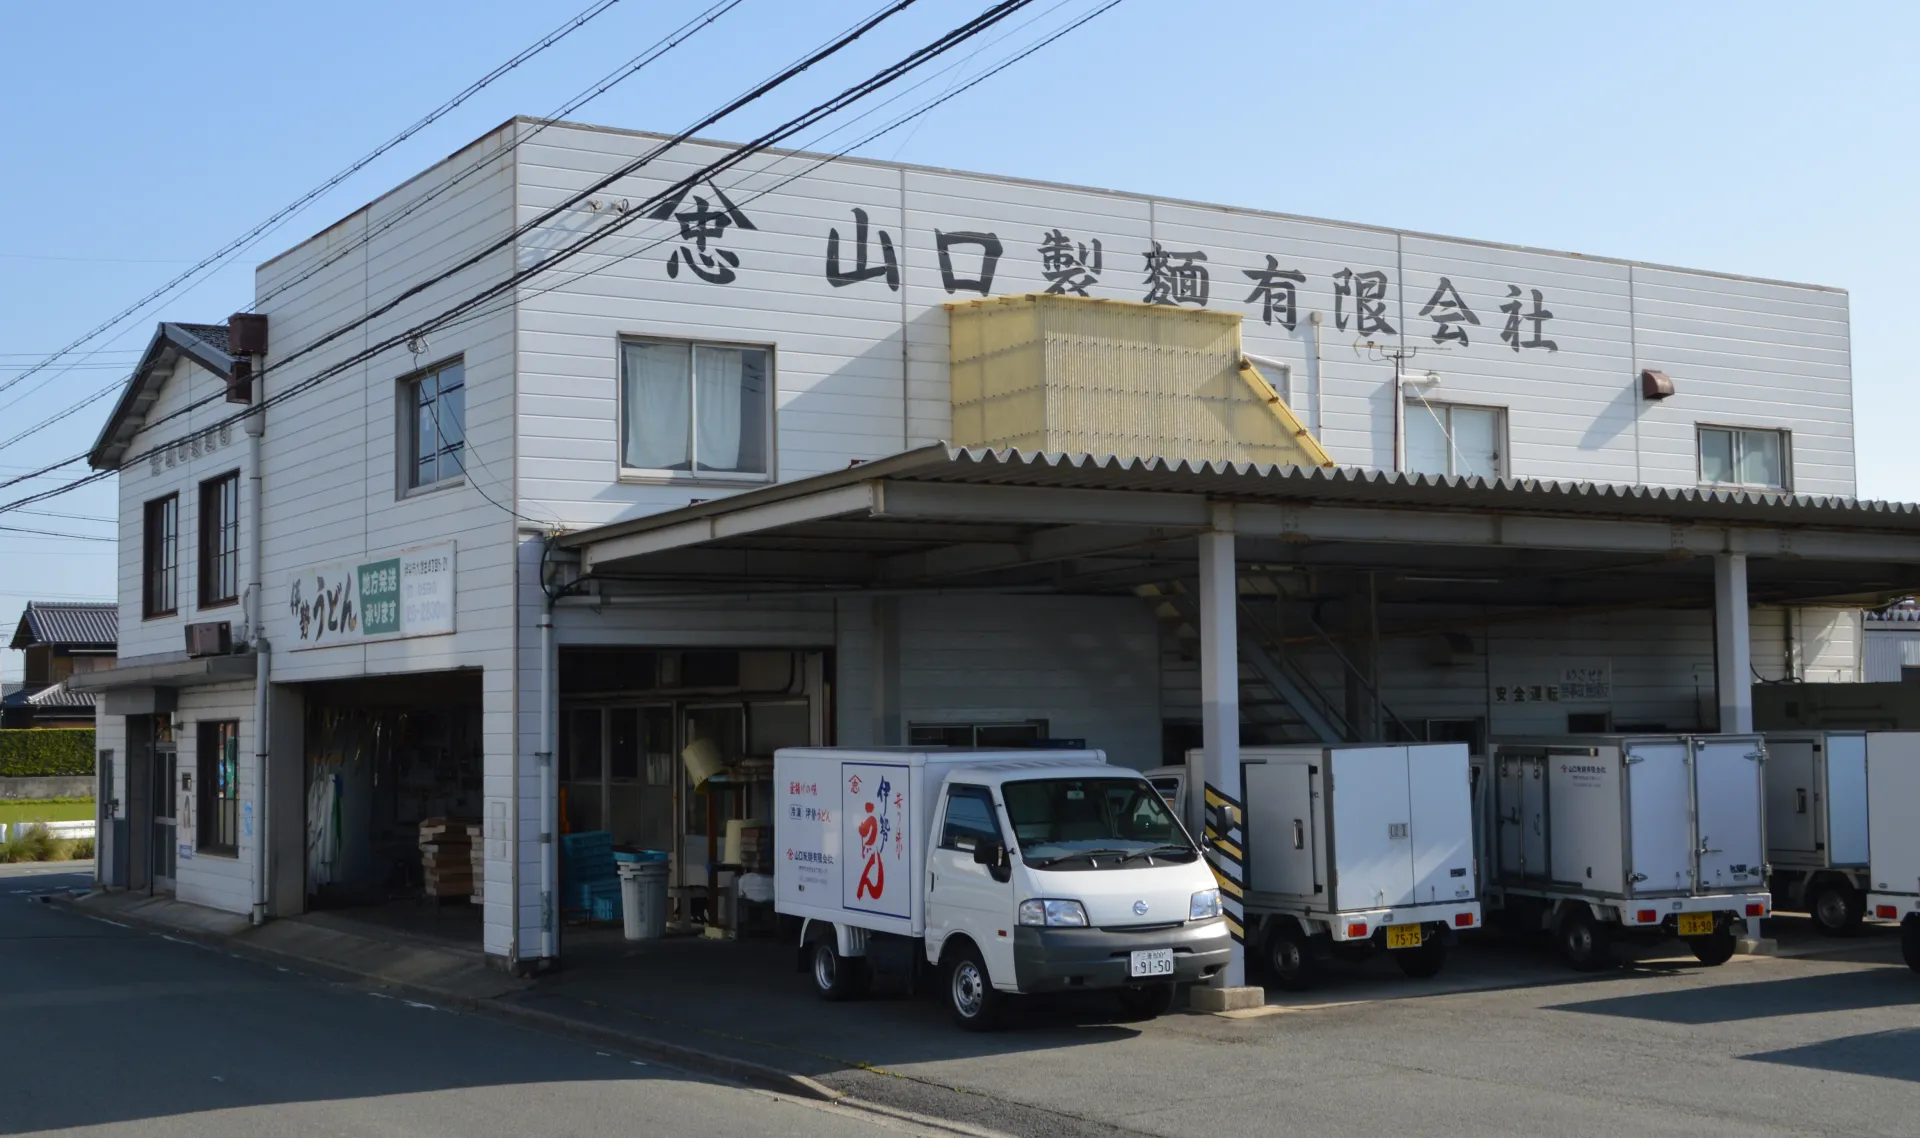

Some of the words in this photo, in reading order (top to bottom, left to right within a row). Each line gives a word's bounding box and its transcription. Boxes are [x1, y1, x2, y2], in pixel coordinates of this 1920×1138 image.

[362, 567, 397, 594] 地方発送
[290, 572, 357, 641] 伊勢うどん
[365, 600, 397, 627] 承ります
[877, 775, 891, 853] 伊勢
[856, 802, 885, 900] うどん
[1140, 960, 1171, 974] 91-50
